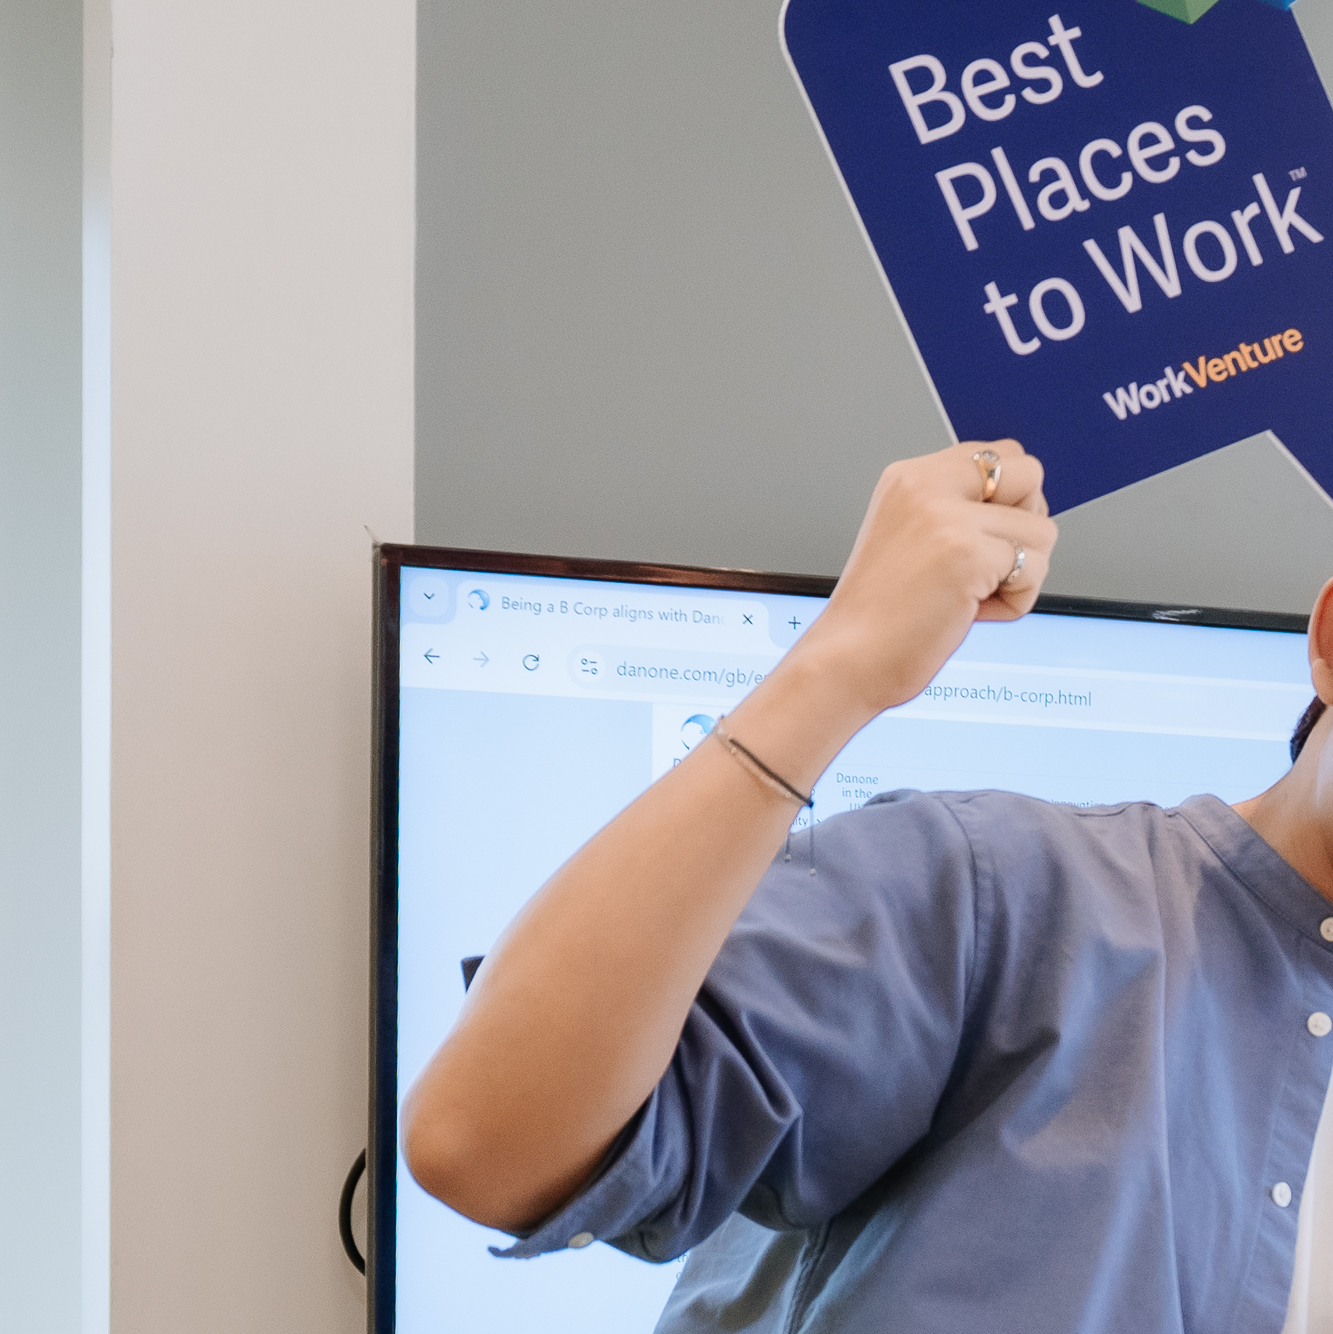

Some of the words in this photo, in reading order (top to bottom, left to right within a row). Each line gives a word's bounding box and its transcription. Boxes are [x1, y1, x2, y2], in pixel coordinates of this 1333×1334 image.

[888, 14, 1104, 145] Best
[935, 105, 1226, 252] Places
[983, 277, 1086, 356] to
[1103, 328, 1304, 420] WorkVenture
[501, 596, 542, 615] Being
[547, 603, 555, 613] a
[560, 601, 569, 614] B
[573, 602, 608, 620] Corp
[612, 604, 654, 622] aligns
[658, 608, 688, 623] with
[836, 772, 879, 785] Danone
[842, 787, 852, 798] in
[855, 788, 873, 799] the
